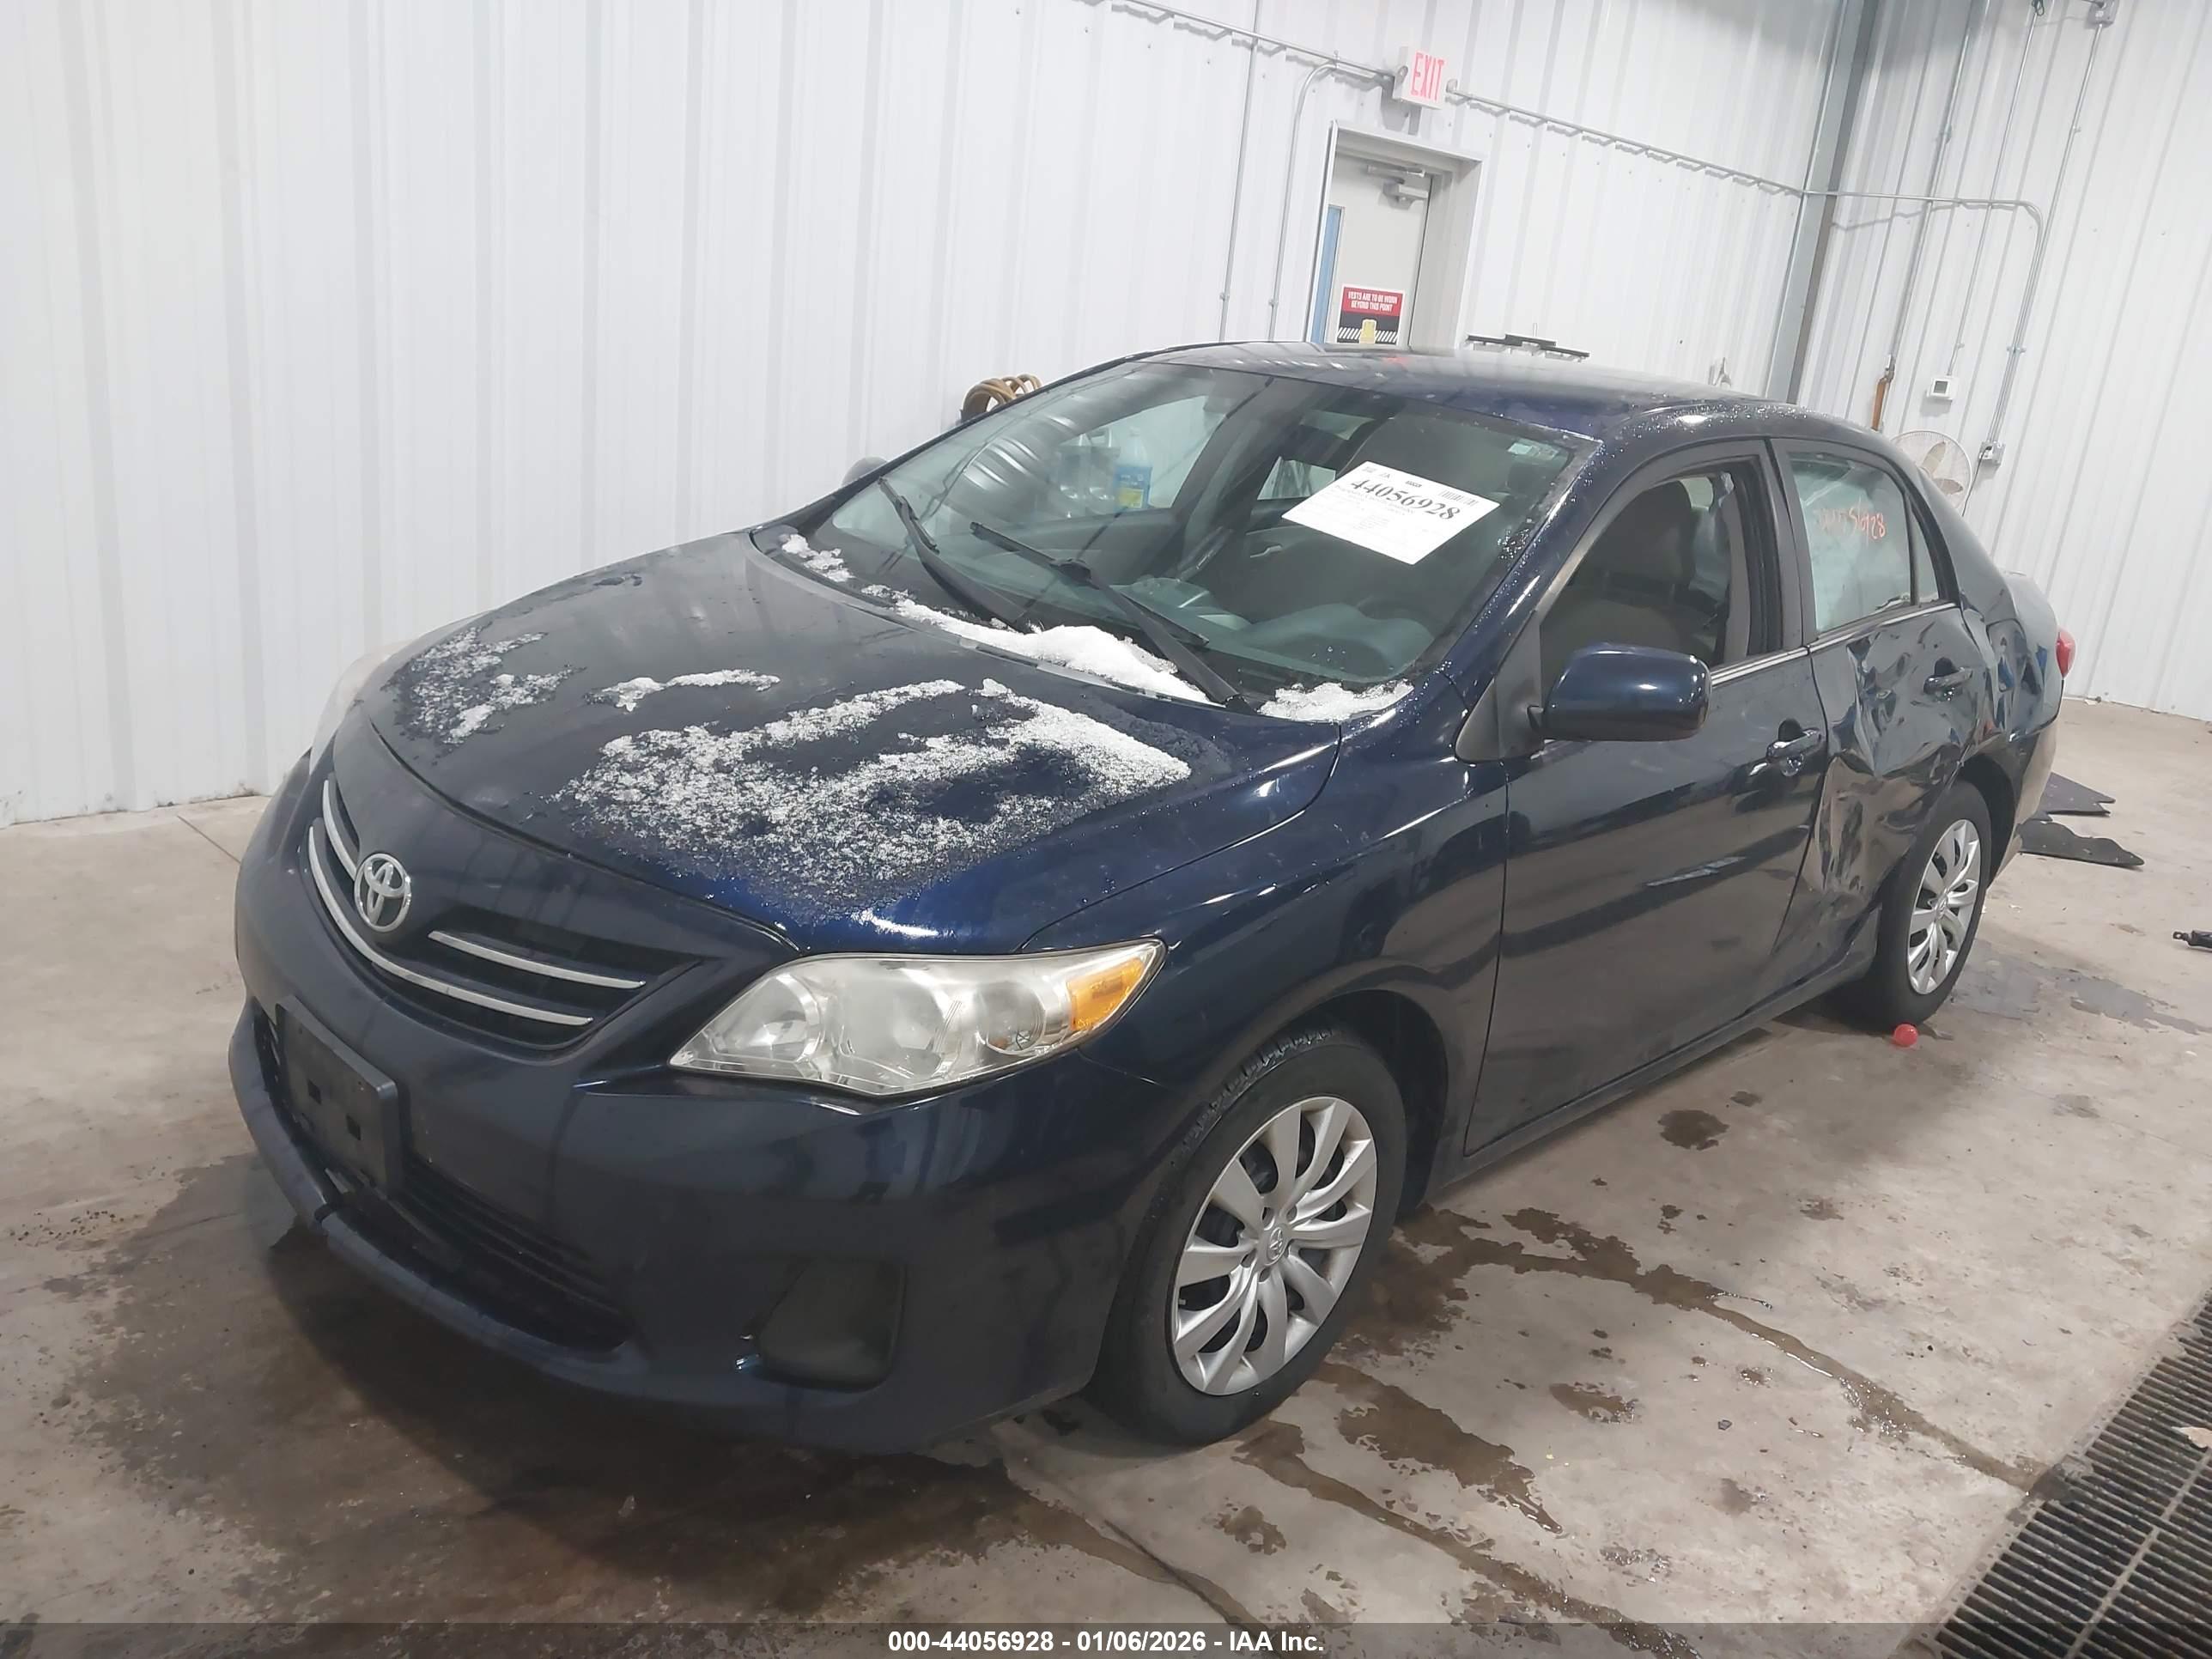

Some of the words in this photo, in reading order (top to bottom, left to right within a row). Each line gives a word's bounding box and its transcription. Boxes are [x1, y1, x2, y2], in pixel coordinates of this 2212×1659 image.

[1411, 52, 1444, 101] EXIT
[1348, 291, 1362, 300] VESTS
[1363, 293, 1371, 301] ARE
[1384, 295, 1398, 304] WORN
[1351, 301, 1369, 309] BEYOND
[1370, 302, 1379, 311] THIS
[1351, 479, 1461, 520] 44056928
